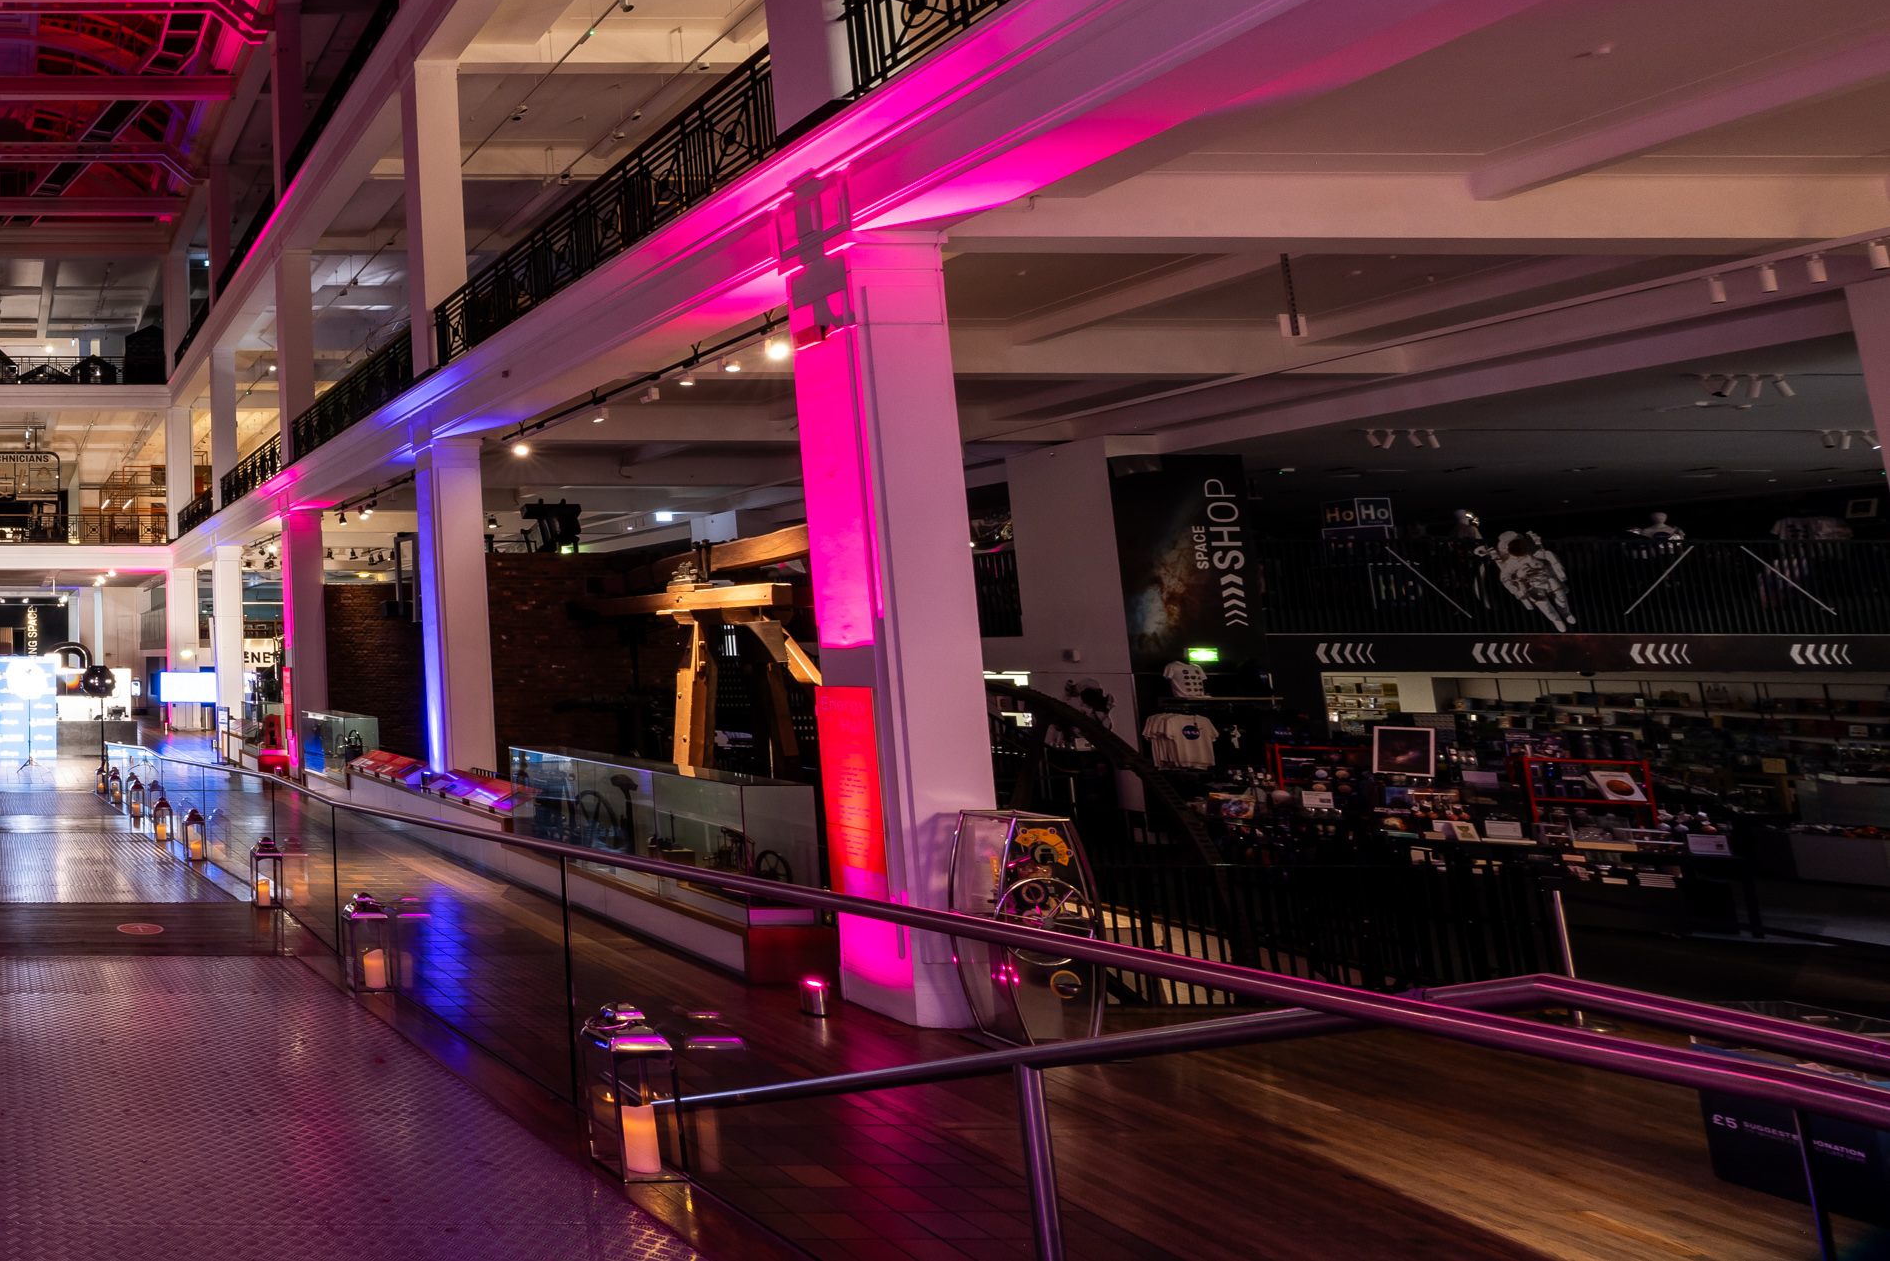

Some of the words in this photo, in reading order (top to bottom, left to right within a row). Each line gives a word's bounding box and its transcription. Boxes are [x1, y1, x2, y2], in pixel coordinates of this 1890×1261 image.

[1203, 478, 1245, 570] SHOP
[1325, 507, 1355, 523] Ho
[1359, 504, 1390, 520] Ho
[1192, 525, 1210, 570] SPACE
[27, 607, 38, 638] SPACE
[821, 695, 866, 716] Energy
[841, 718, 868, 733] Hall
[1712, 1113, 1739, 1130] £5
[1742, 1121, 1800, 1141] SUGGESTE
